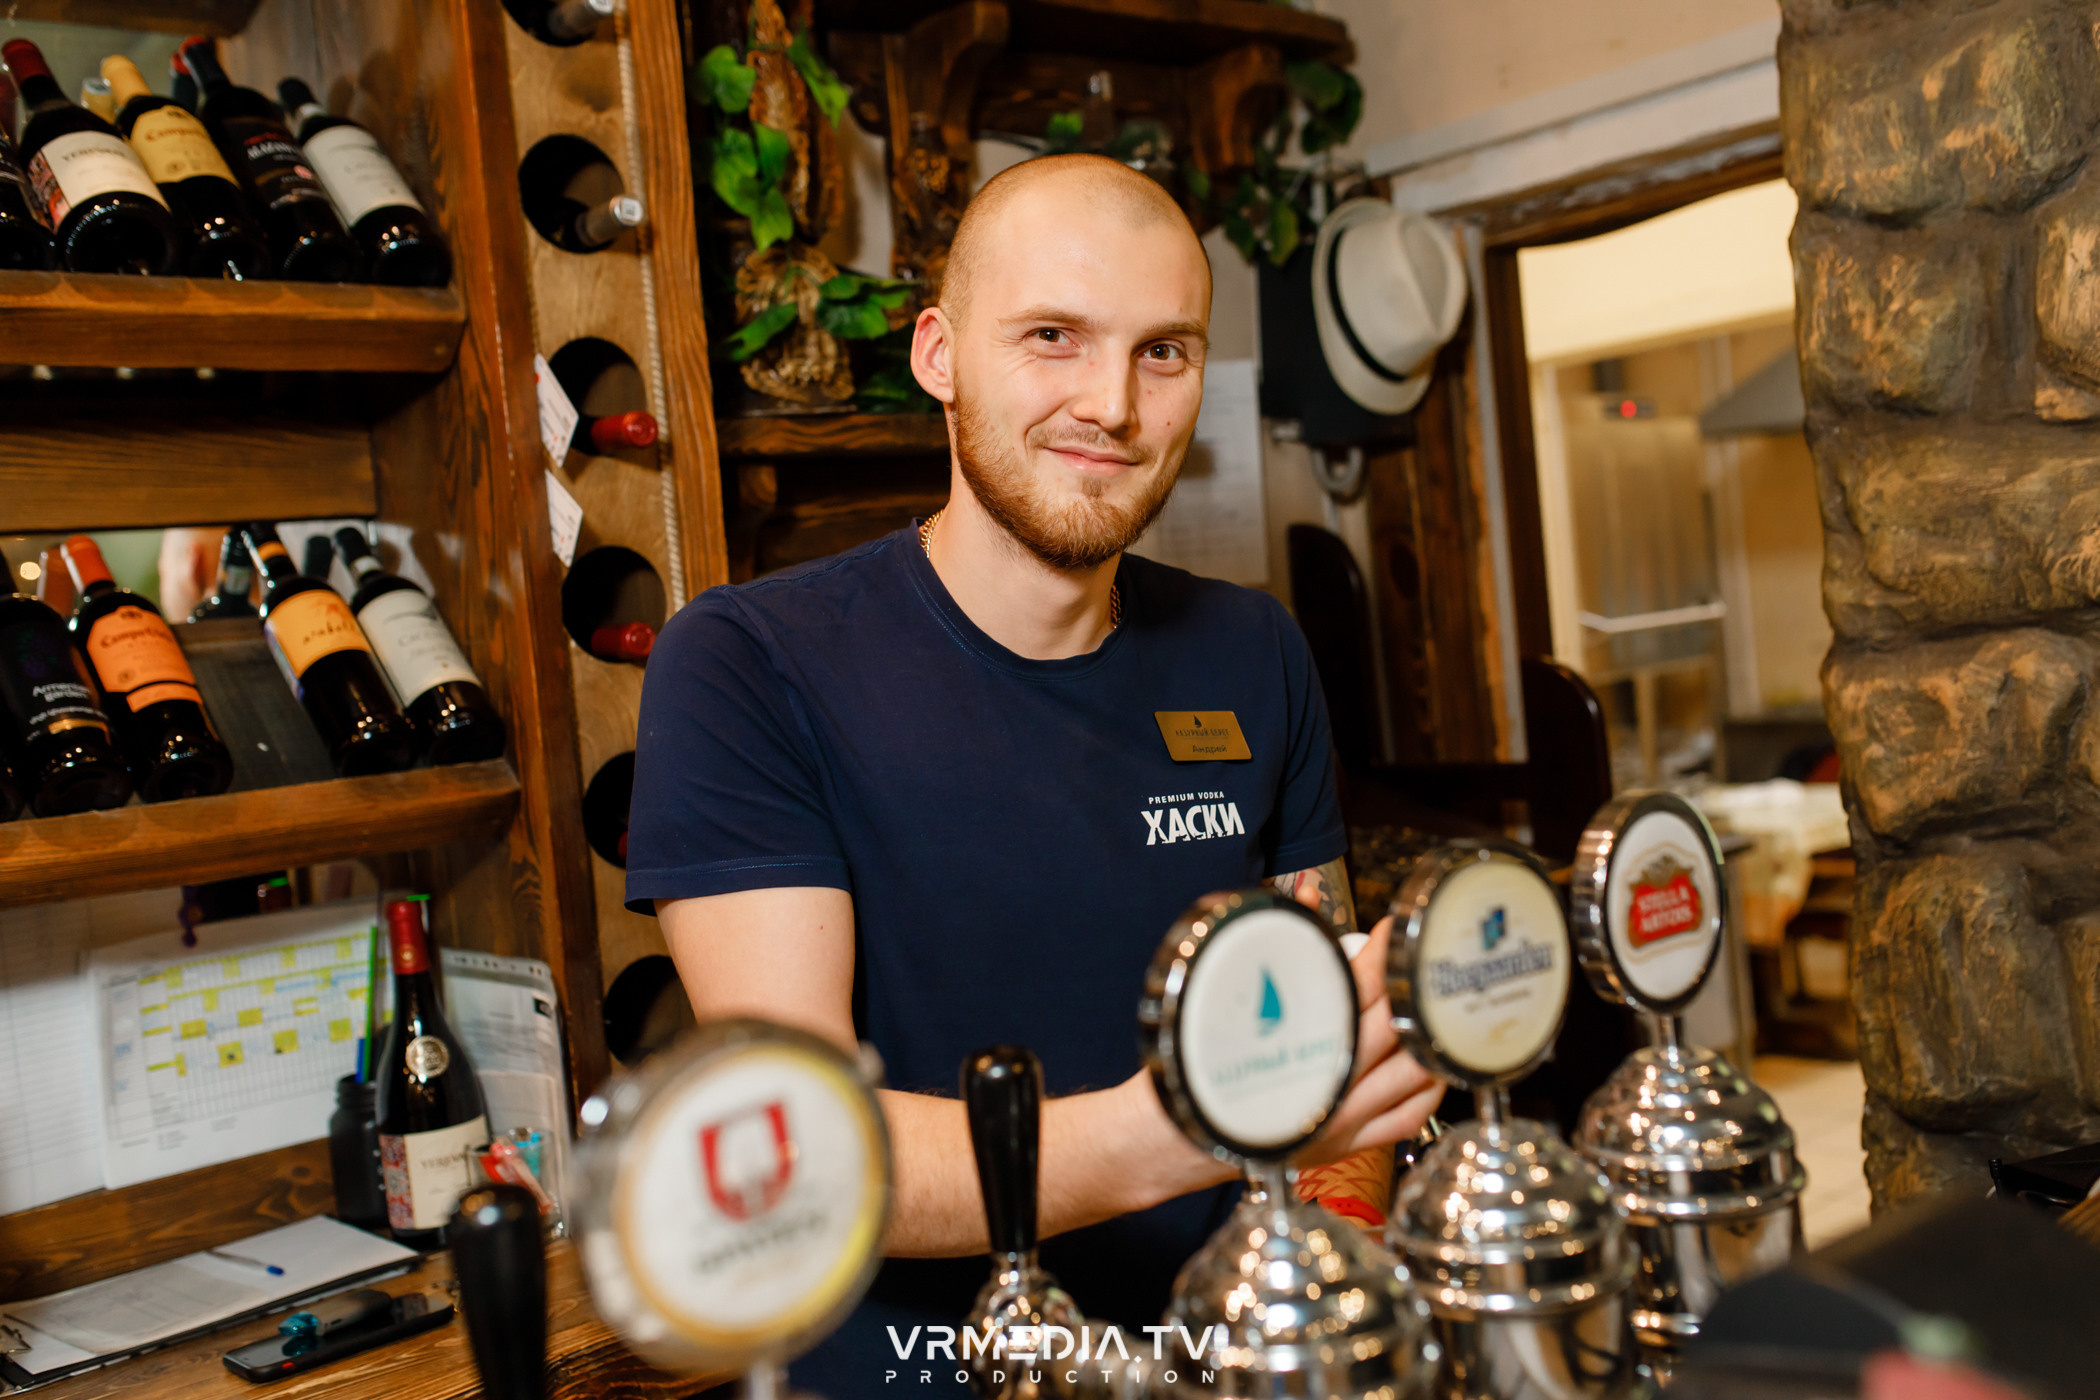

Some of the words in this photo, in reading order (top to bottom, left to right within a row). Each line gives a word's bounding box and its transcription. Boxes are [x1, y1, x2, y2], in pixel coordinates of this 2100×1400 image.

[1192, 745, 1227, 754] Андрей
[1148, 793, 1194, 804] PREMIUM
[1198, 791, 1224, 799] VODKA
[1141, 802, 1245, 845] ХАСКИ
